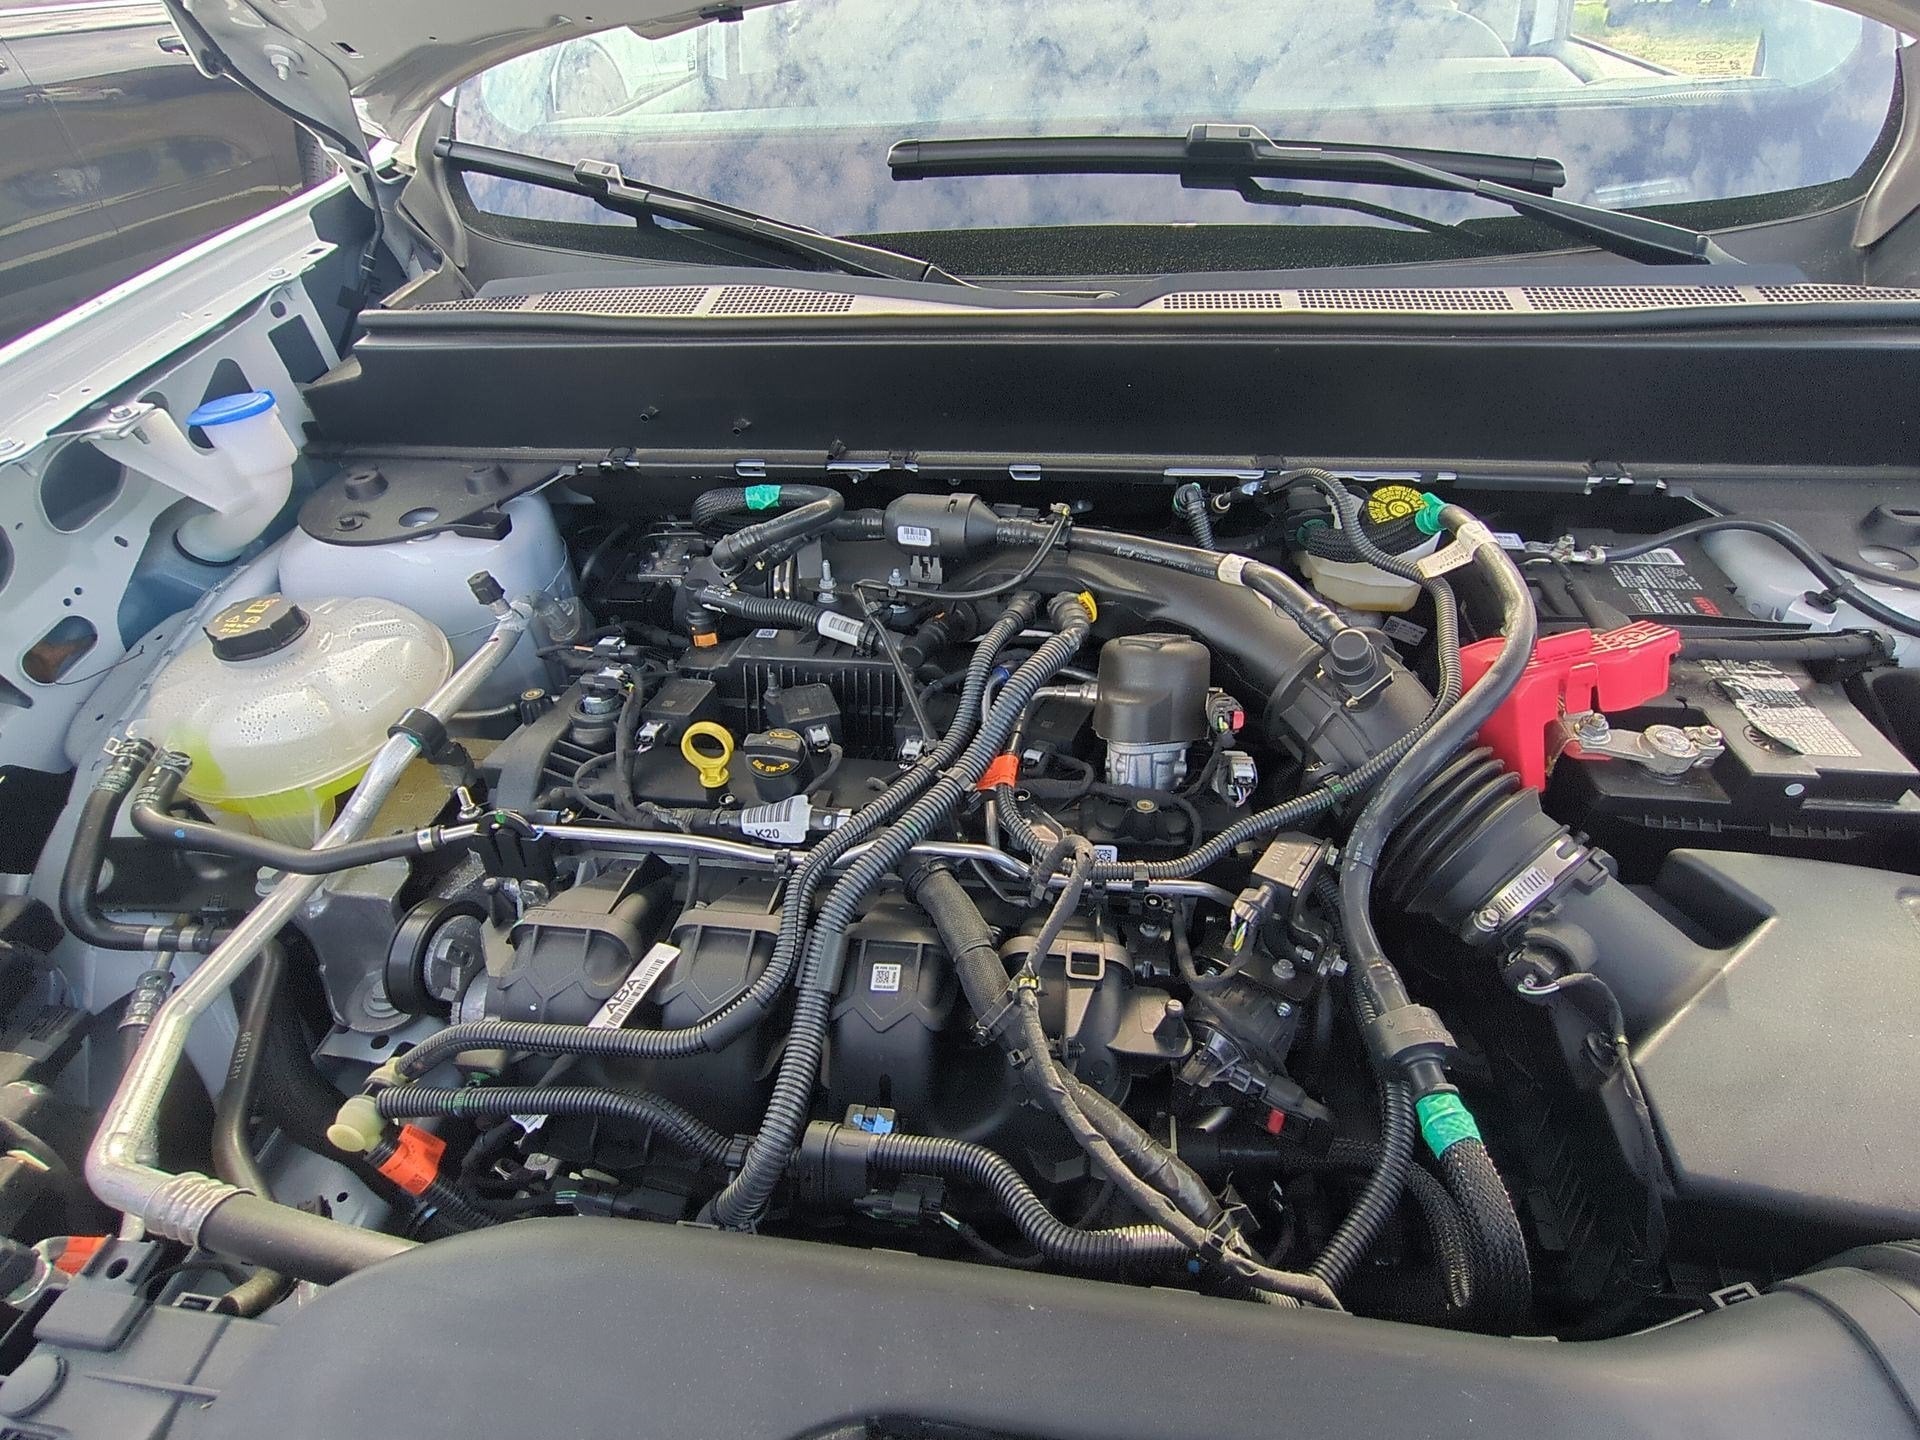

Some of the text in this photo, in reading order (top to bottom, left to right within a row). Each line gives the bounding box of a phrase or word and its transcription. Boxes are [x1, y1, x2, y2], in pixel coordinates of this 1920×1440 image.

[765, 762, 790, 772] 5W-30
[755, 828, 780, 839] K20
[606, 978, 641, 1014] ABA
